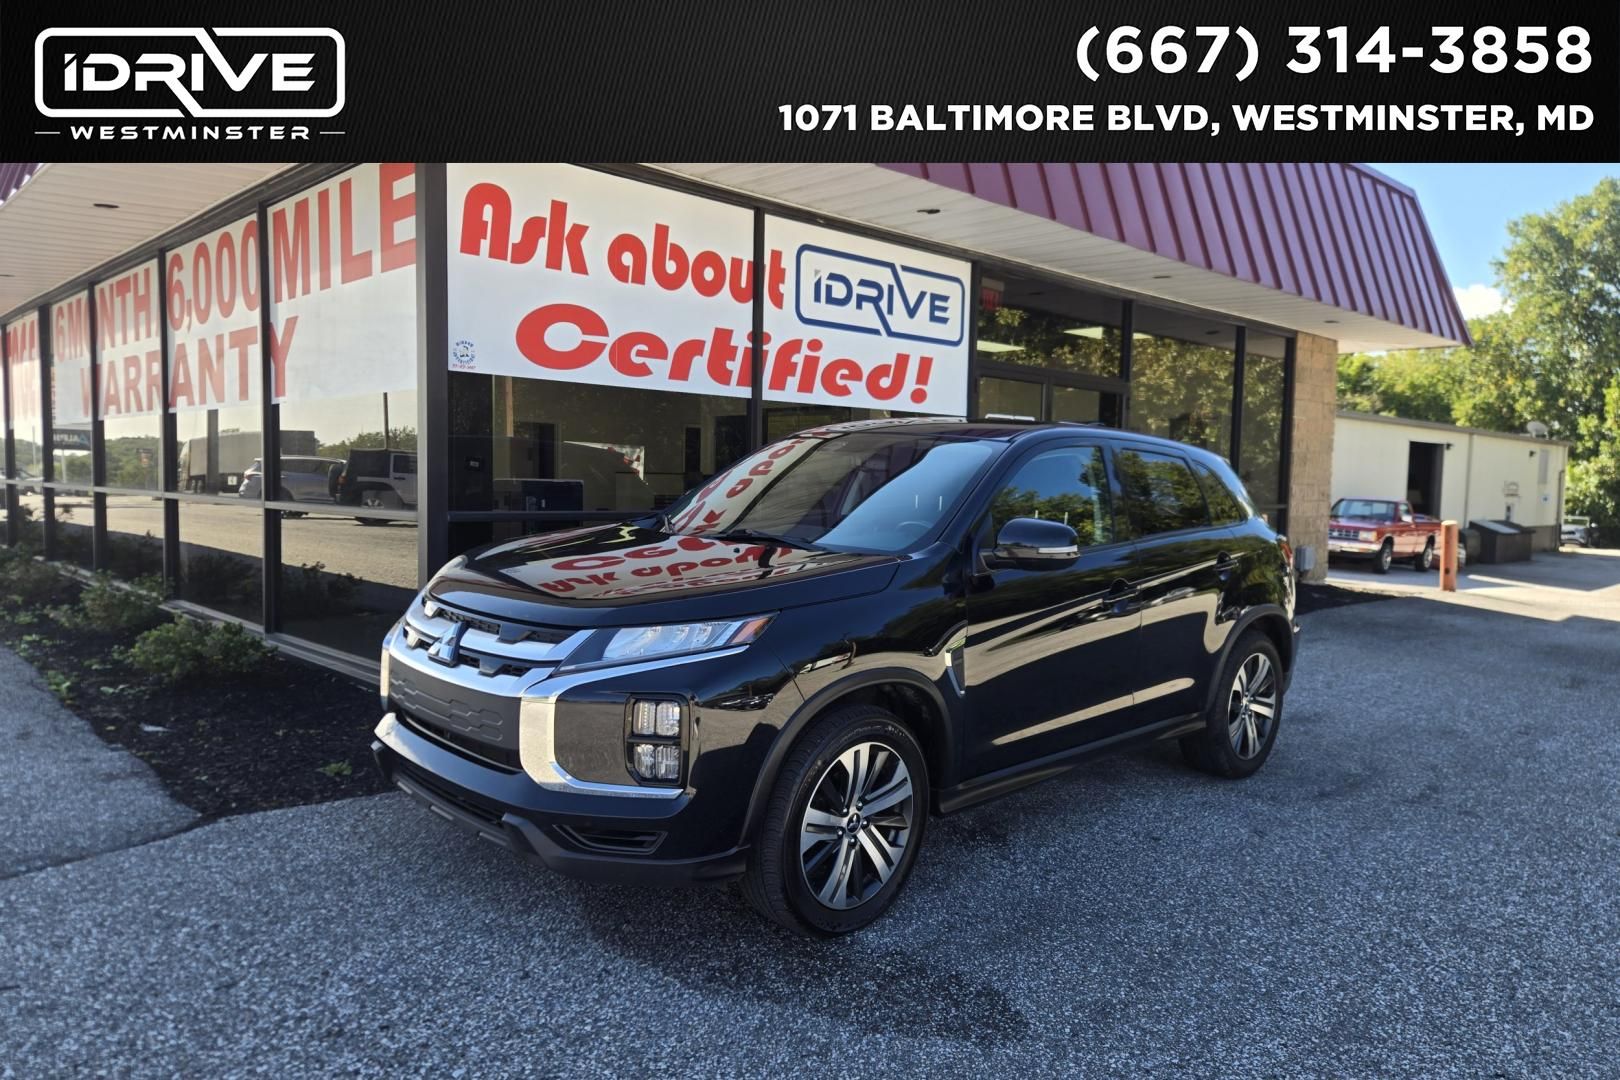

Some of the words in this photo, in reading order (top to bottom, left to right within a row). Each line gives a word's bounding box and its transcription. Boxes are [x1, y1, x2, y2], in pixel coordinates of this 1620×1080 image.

[272, 163, 416, 303] MILE
[459, 182, 590, 276] Ask
[607, 223, 786, 310] about
[515, 303, 934, 404] Certified!
